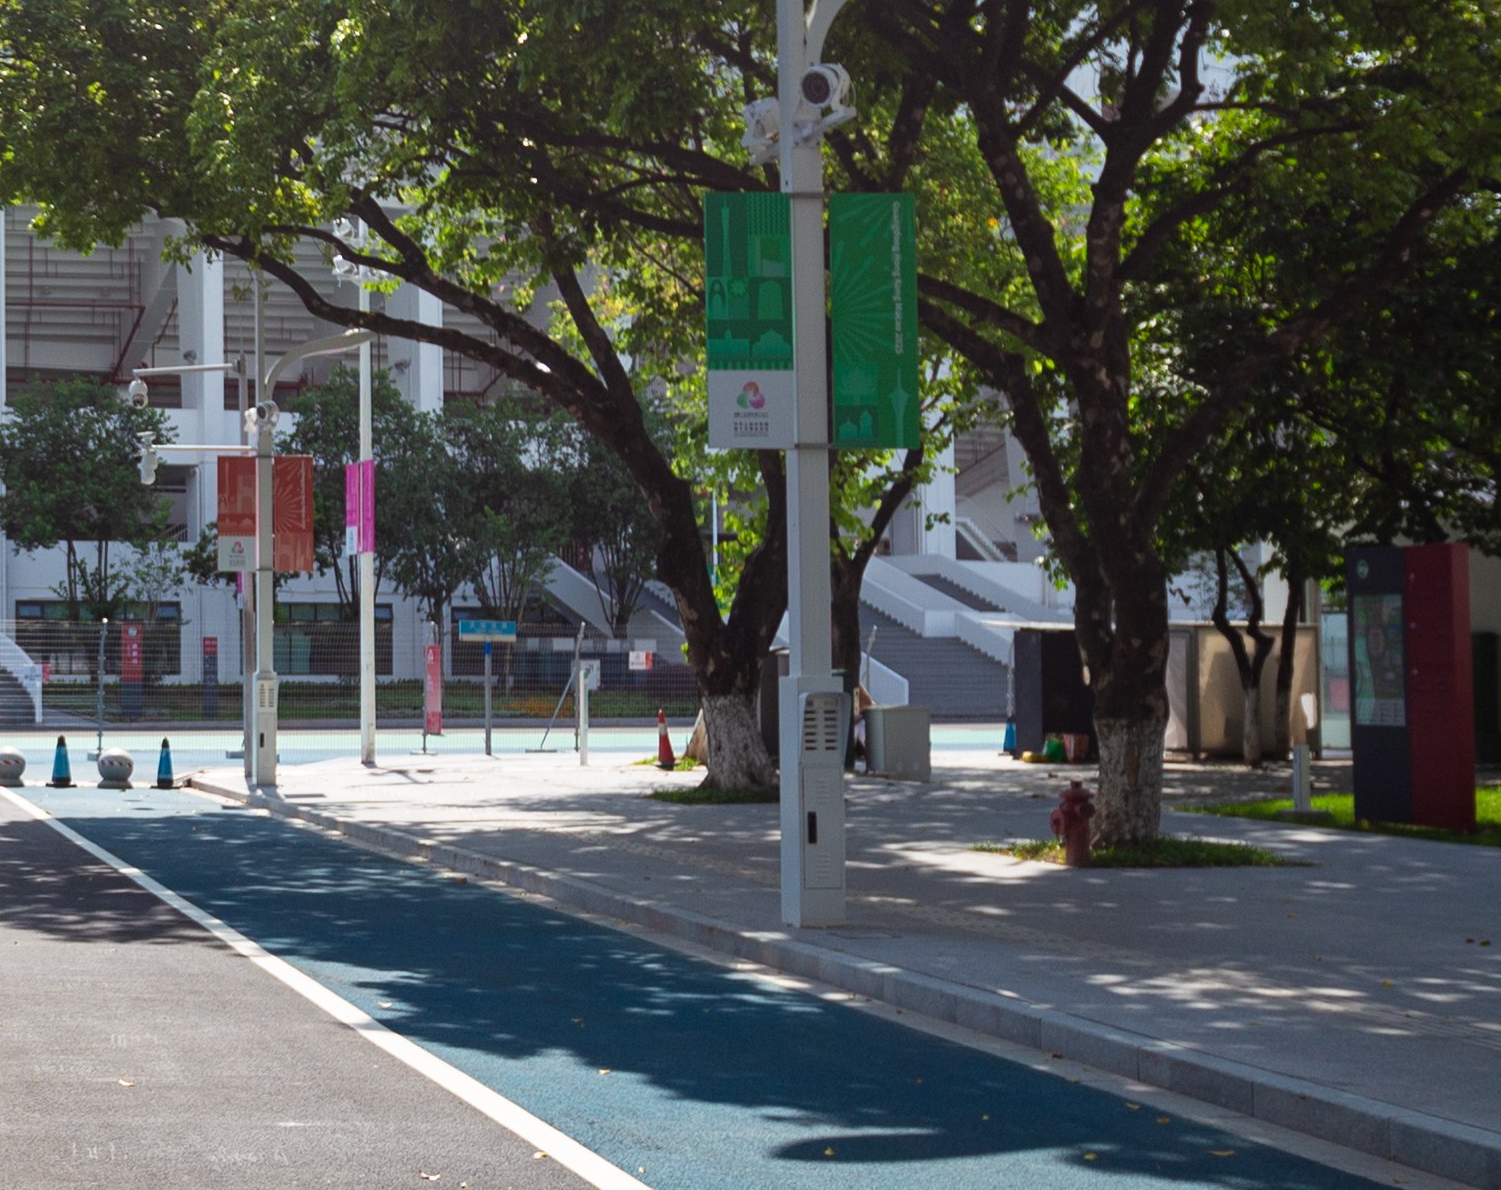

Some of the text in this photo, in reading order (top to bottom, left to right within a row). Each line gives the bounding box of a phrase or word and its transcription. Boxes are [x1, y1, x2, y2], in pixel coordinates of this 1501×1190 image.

[892, 253, 902, 277] Hong
[892, 278, 902, 301] Kong
[894, 303, 903, 331] Macao
[895, 333, 904, 355] 2025
